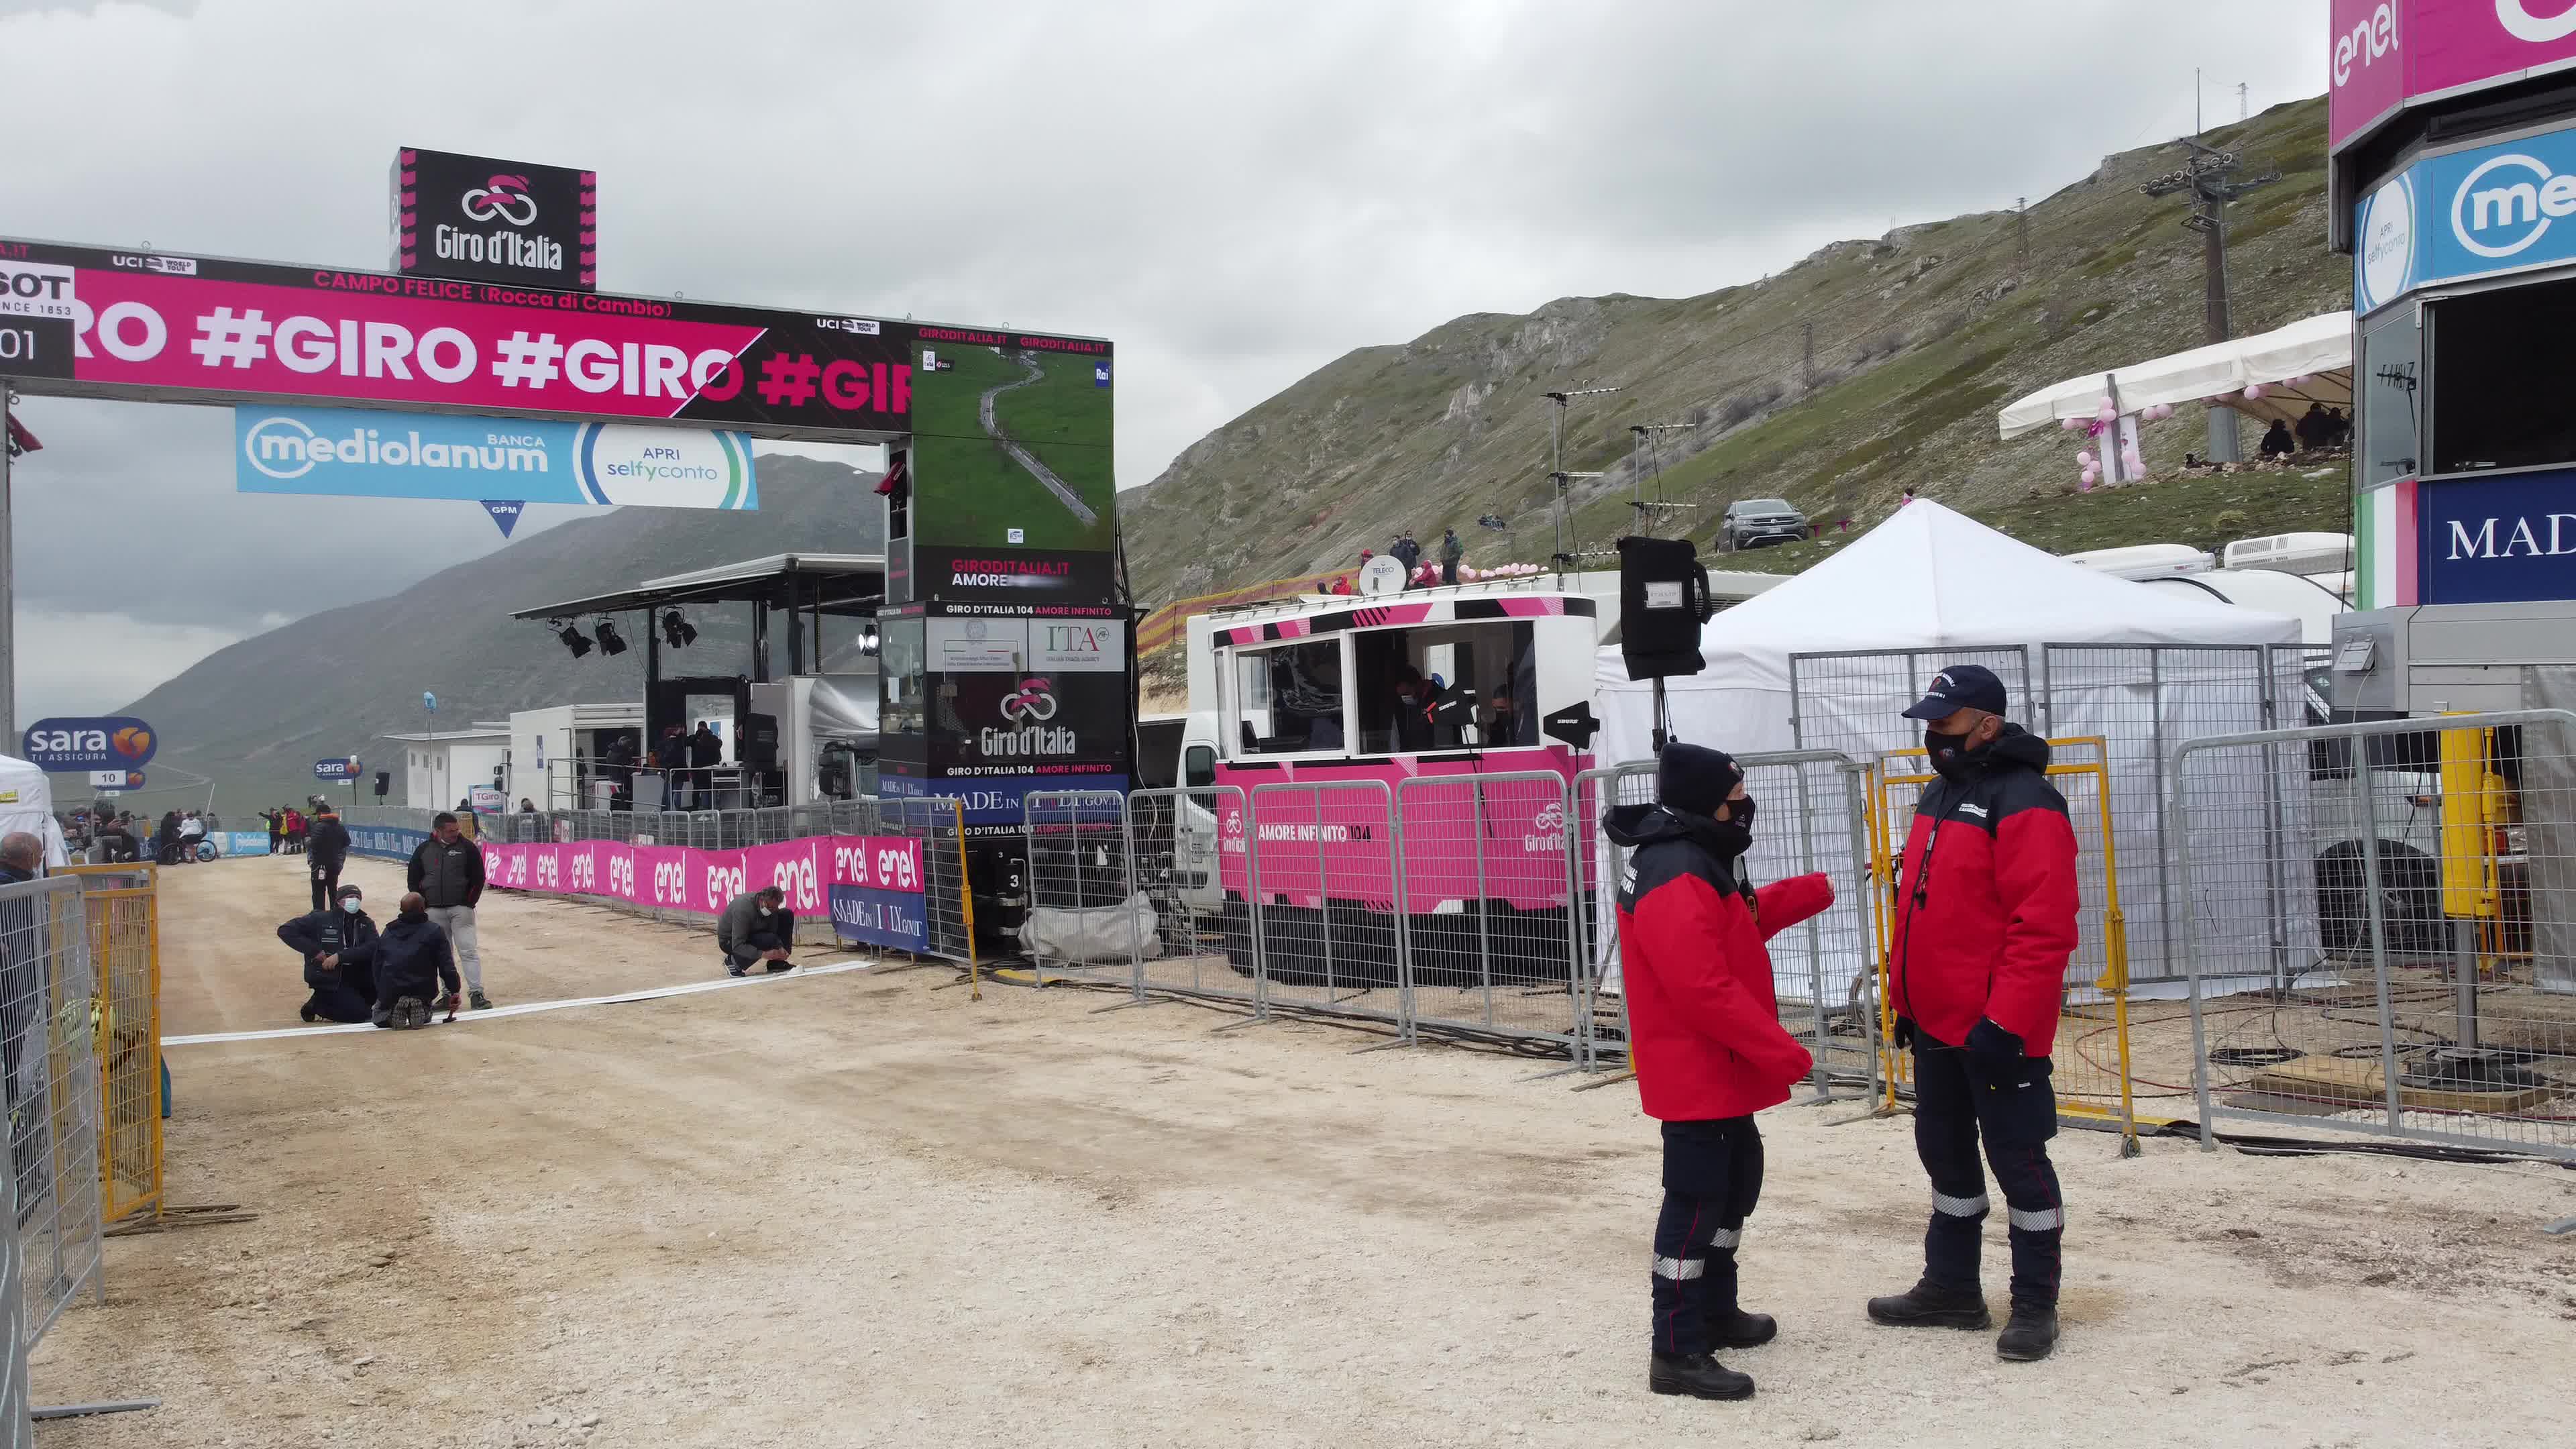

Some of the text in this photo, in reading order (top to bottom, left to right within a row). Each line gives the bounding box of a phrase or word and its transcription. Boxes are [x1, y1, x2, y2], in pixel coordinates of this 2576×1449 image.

[2334, 0, 2398, 87] enel
[2380, 220, 2393, 236] APRI
[435, 224, 562, 270] Giro d'Italia
[2368, 233, 2405, 264] selfyconto
[113, 256, 142, 268] UCI
[314, 270, 671, 317] CAMPO FELICE (Rocca di Cambio)
[40, 305, 70, 315] 1853
[816, 318, 839, 329] UCI
[919, 327, 1007, 344] GIRODITALIA.IT
[1020, 337, 1106, 354] GIRODITALIA.IT
[191, 307, 477, 383] #GIRO
[492, 330, 743, 402] #GIRO
[1096, 368, 1110, 381] Rai
[487, 433, 545, 448] BANCA
[261, 428, 549, 472] mediolanum
[643, 447, 680, 460] APRI
[606, 460, 718, 482] selfyconto
[491, 506, 517, 515] GPM
[2447, 513, 2576, 561] MAD
[952, 559, 1071, 576] GIRODITALIA.IT
[952, 573, 1007, 587] AMORE
[947, 605, 1112, 616] GIRO D'ITALIA 104 AMORE INFINITO
[1046, 626, 1099, 651] ITA
[31, 729, 107, 752] sara
[981, 727, 1075, 756] Giro d'Italia
[32, 753, 107, 761] TI ASSICURA
[316, 763, 344, 773] sara
[947, 764, 1112, 775] GIRO D'ITALIA 104 AMORE INFINITO
[101, 773, 115, 783] 10
[1006, 798, 1019, 808] IN
[974, 826, 1015, 835] D'ITALIA
[1258, 824, 1371, 843] AMORE INFINITO 104
[1525, 835, 1546, 852] Giro
[835, 839, 868, 883] enel
[878, 840, 917, 888] enel
[508, 847, 526, 884] enel
[537, 847, 558, 888] enel
[572, 843, 595, 889] enel
[610, 849, 634, 897] enel
[655, 850, 686, 904] enel
[707, 853, 747, 910] enel
[773, 842, 820, 910] enel
[1010, 874, 1019, 888] 3
[833, 898, 866, 926] MADE
